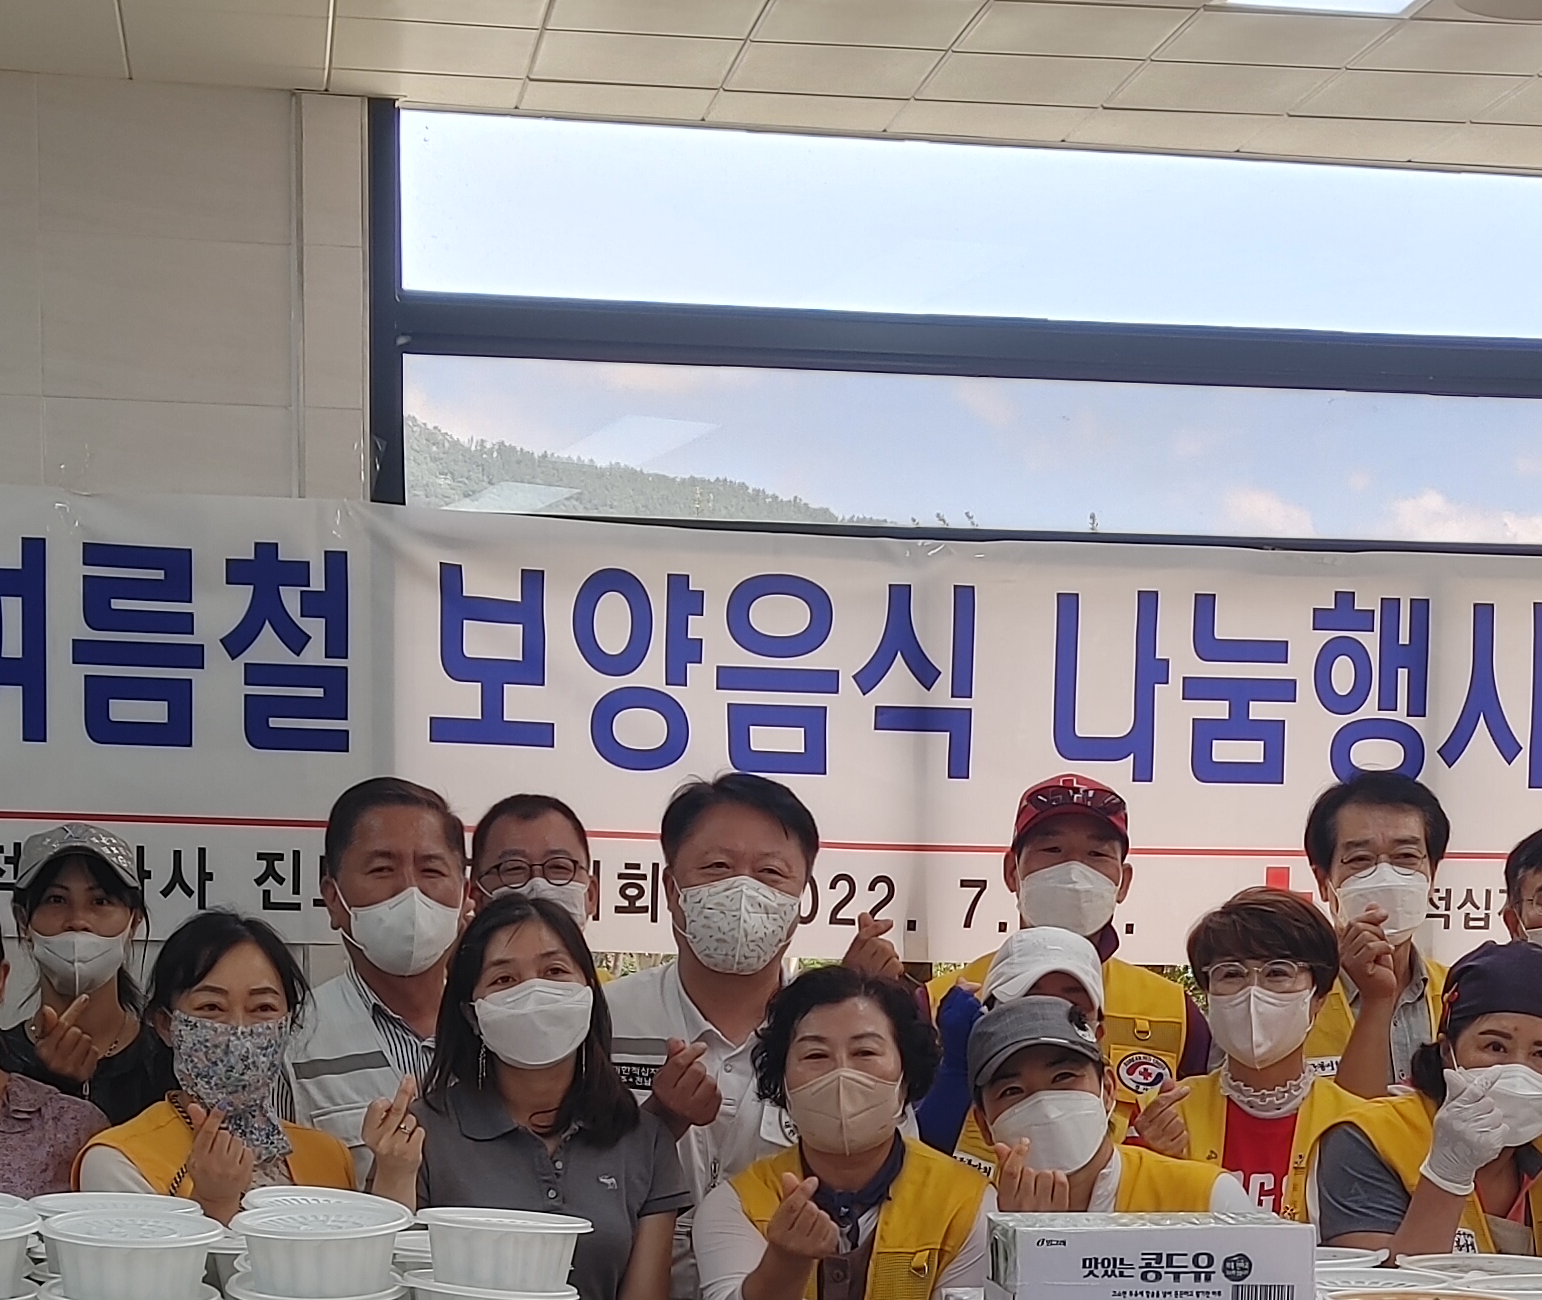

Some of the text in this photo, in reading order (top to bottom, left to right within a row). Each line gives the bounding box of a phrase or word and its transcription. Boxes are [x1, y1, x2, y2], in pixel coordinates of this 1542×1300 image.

[428, 562, 976, 781] 보양음식
[1081, 1256, 1135, 1279] 맛있는
[1138, 1251, 1217, 1283] 콩두유
